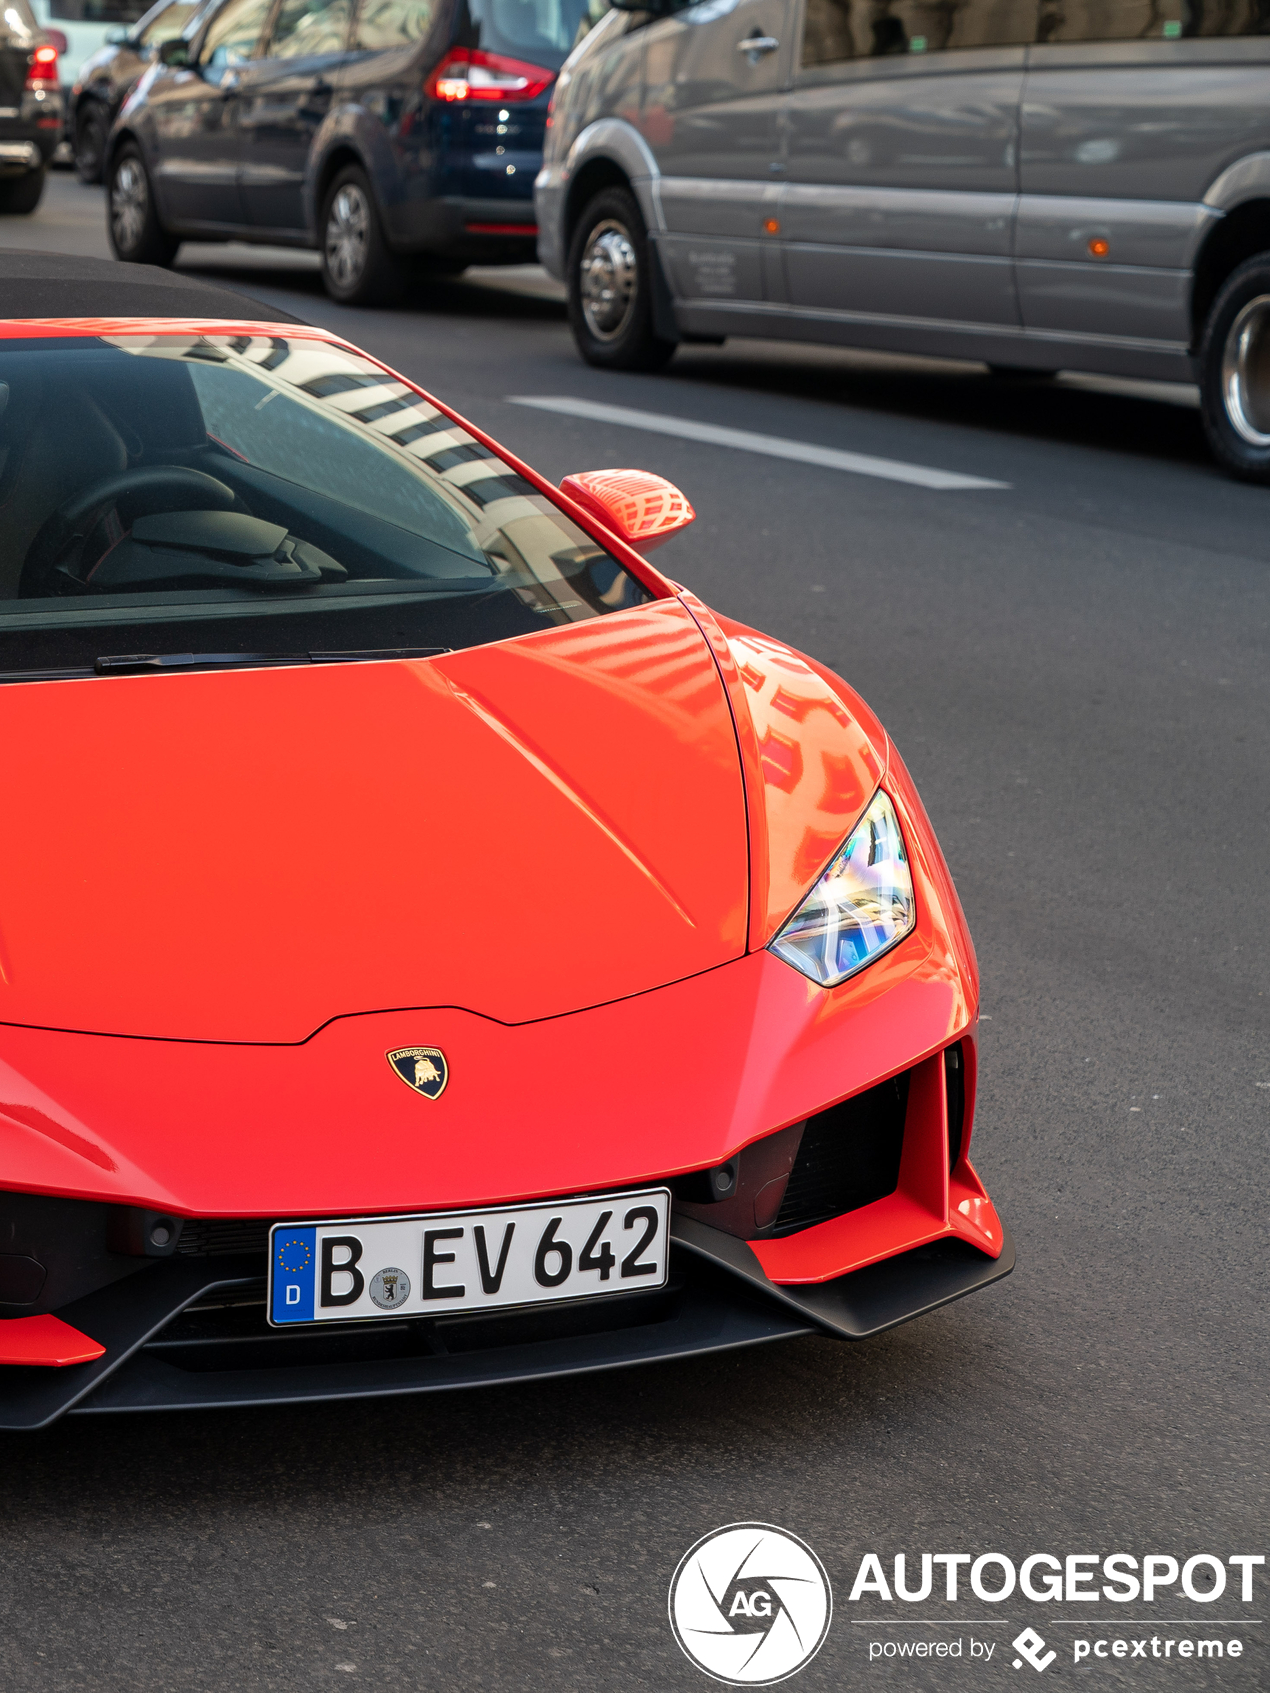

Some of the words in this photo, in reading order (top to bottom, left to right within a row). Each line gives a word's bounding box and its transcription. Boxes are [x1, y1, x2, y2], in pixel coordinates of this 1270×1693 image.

[391, 1049, 441, 1061] LAMBORGHINI
[319, 1236, 365, 1308] B
[422, 1222, 516, 1301] EV
[534, 1205, 659, 1288] 642
[286, 1285, 301, 1305] D
